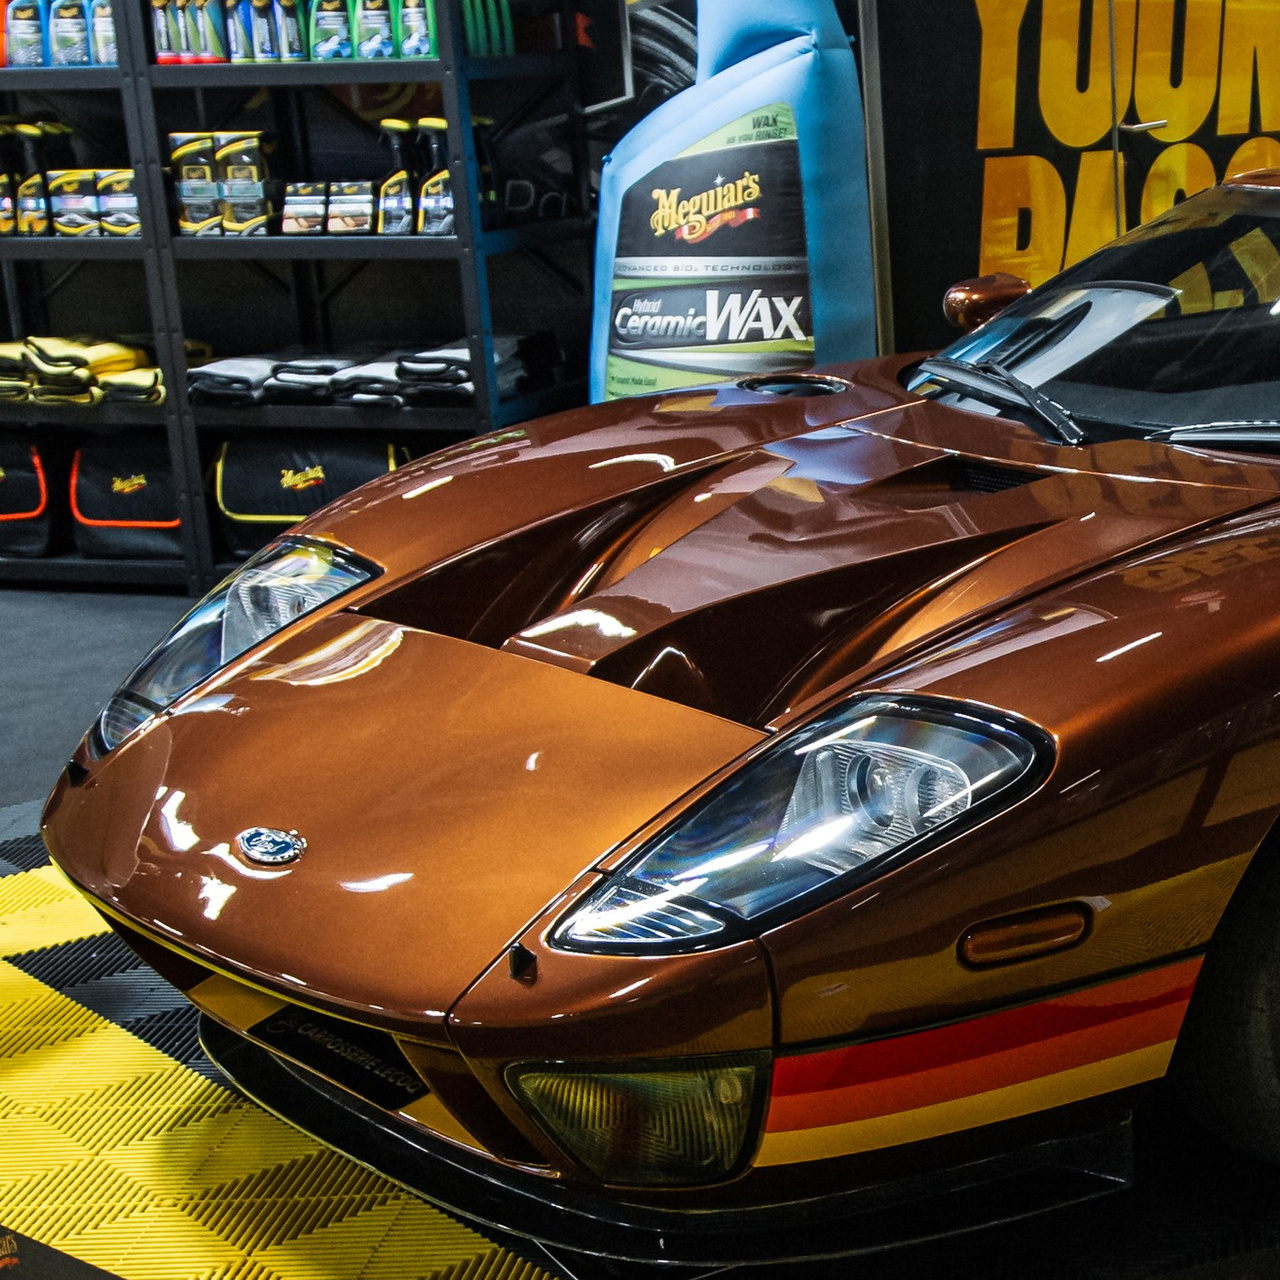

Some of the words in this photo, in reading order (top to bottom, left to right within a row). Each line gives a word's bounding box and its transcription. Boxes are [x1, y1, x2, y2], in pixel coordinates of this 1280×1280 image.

[752, 113, 779, 130] WAX
[650, 171, 762, 240] Meguiar's
[615, 306, 707, 338] Ceramic
[705, 289, 807, 341] WAX
[297, 1022, 377, 1070] CARROSSERIE
